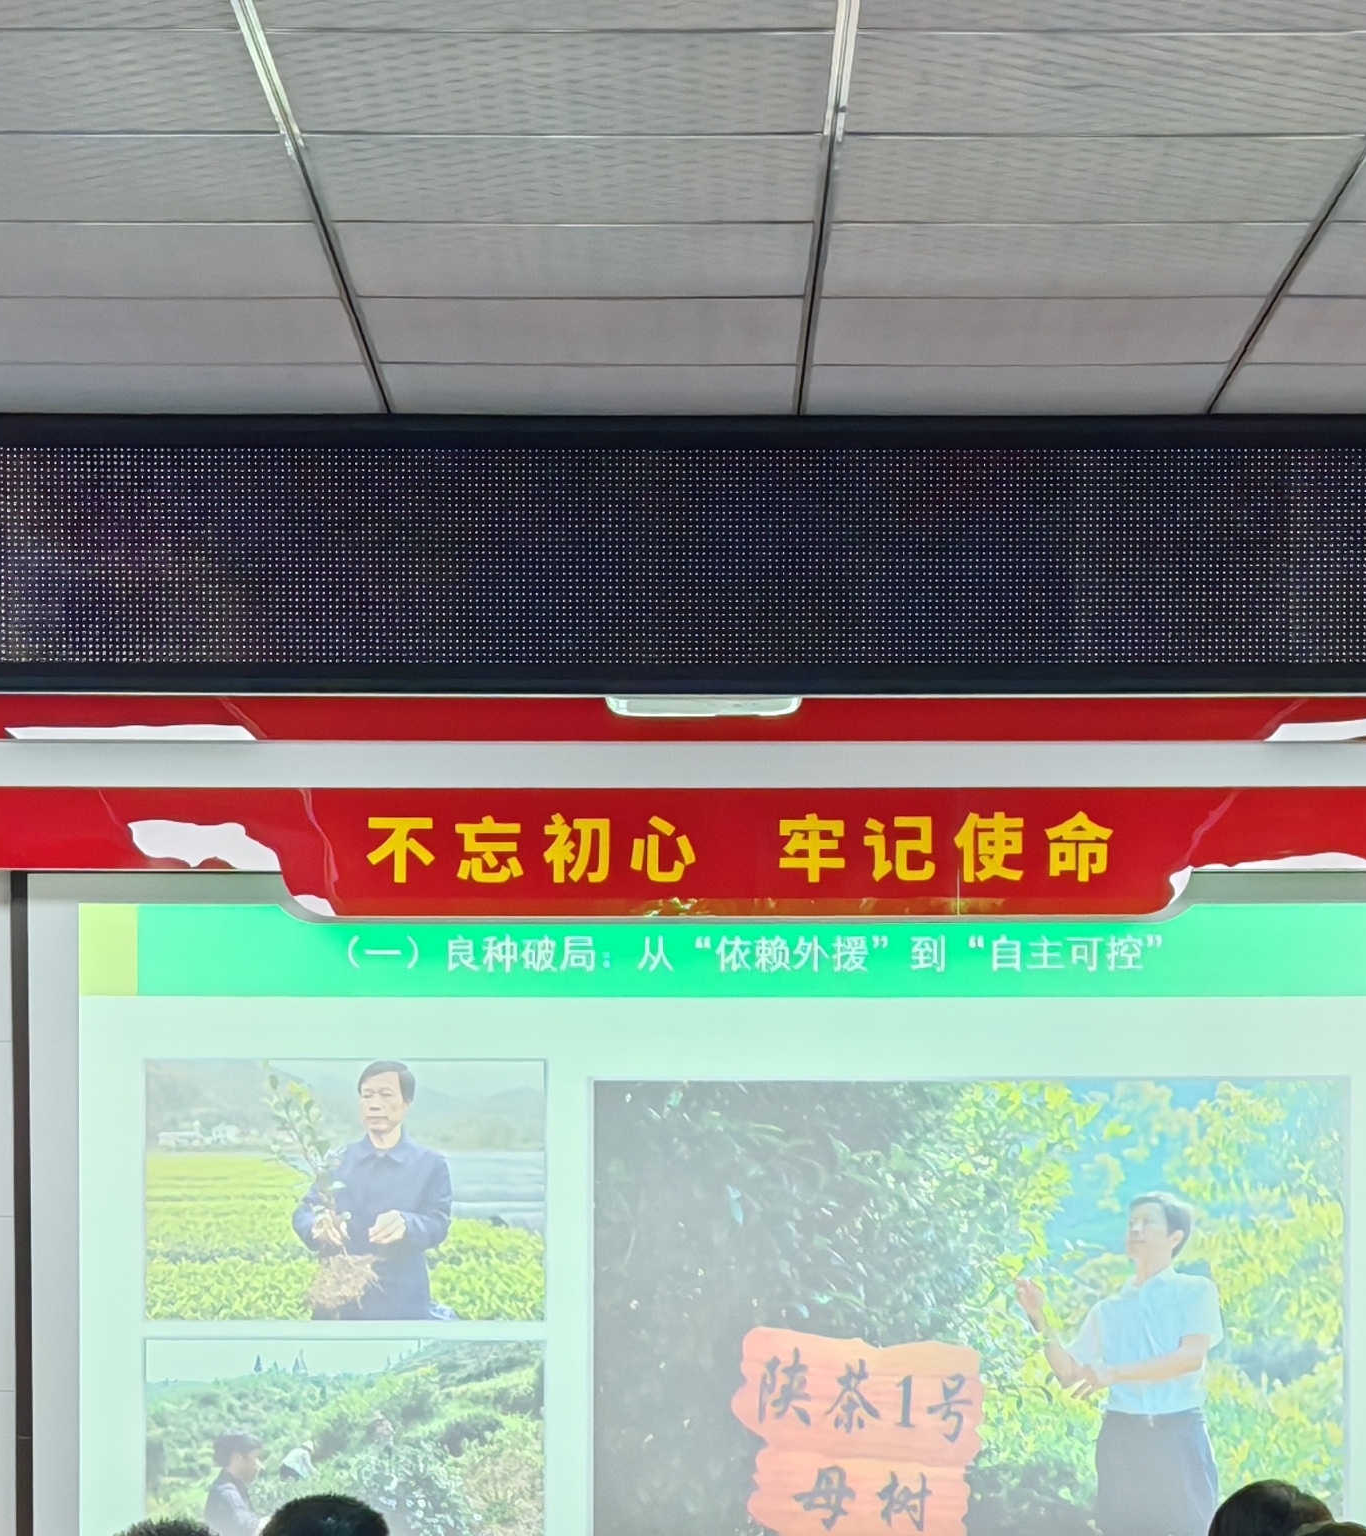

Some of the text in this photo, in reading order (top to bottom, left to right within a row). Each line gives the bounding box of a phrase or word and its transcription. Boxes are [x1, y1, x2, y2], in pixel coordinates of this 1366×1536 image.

[366, 810, 1114, 884] 不忘初心 牢记使命
[757, 1346, 974, 1444] 陕茶1号
[792, 1464, 933, 1533] 母树
